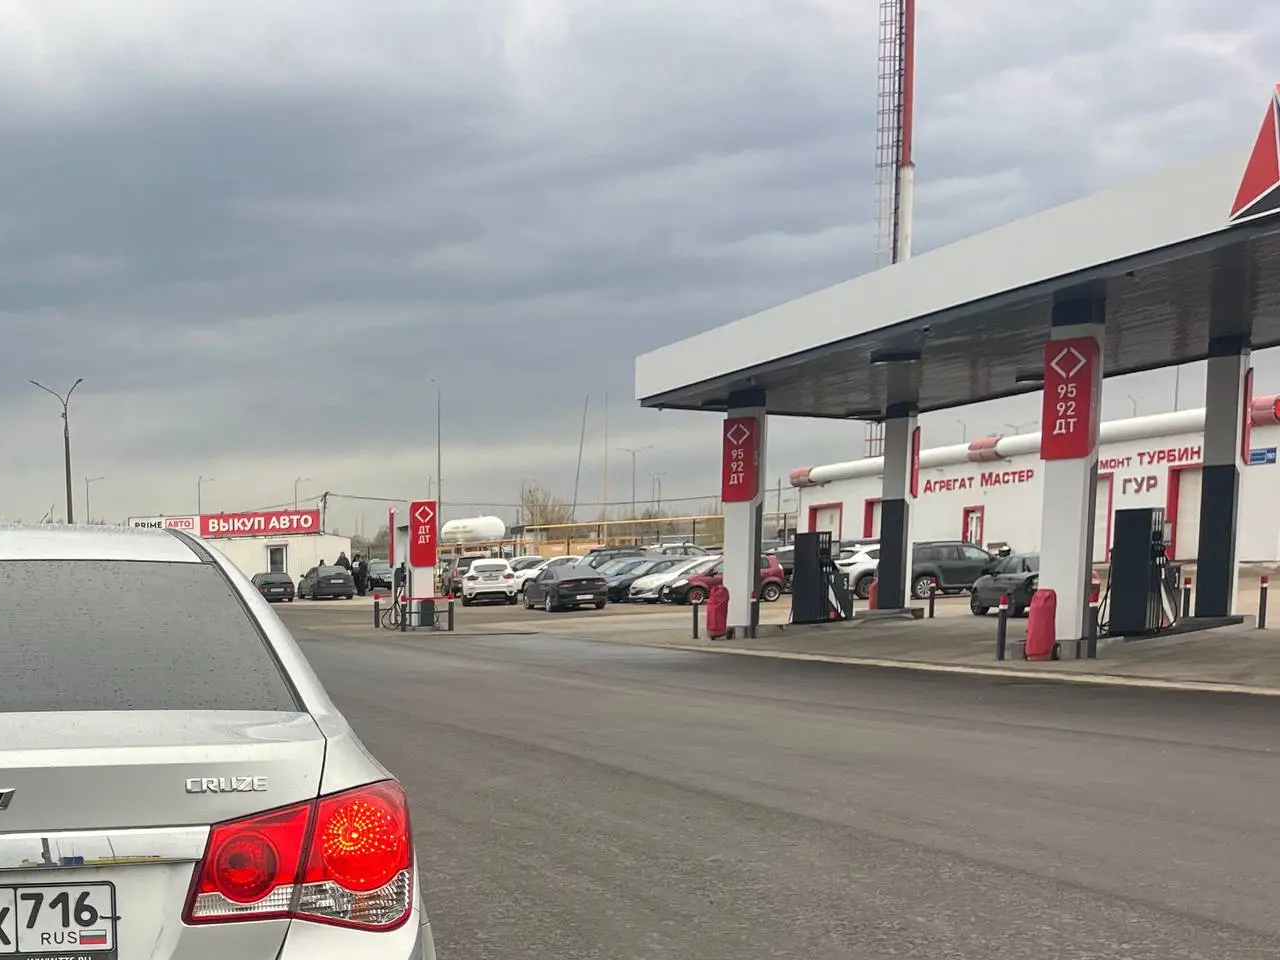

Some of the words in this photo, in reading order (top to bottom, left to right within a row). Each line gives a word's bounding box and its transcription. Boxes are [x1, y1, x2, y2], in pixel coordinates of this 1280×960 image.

[1057, 383, 1077, 399] 95
[1056, 401, 1076, 416] 92
[1053, 418, 1077, 435] ДТ
[731, 448, 744, 460] 95
[1097, 457, 1132, 469] МОНТ
[1137, 446, 1202, 466] ТУРБИН
[731, 461, 744, 472] 92
[729, 473, 744, 485] ДТ
[1122, 475, 1158, 494] ГУР
[167, 520, 191, 528] АВТО
[208, 516, 265, 532] ВЫКУП
[269, 514, 313, 529] АВТО
[418, 525, 431, 534] ДТ
[417, 535, 431, 544] ДТ
[186, 776, 268, 793] CRUZE
[20, 891, 98, 929] 716
[40, 931, 78, 945] RUS
